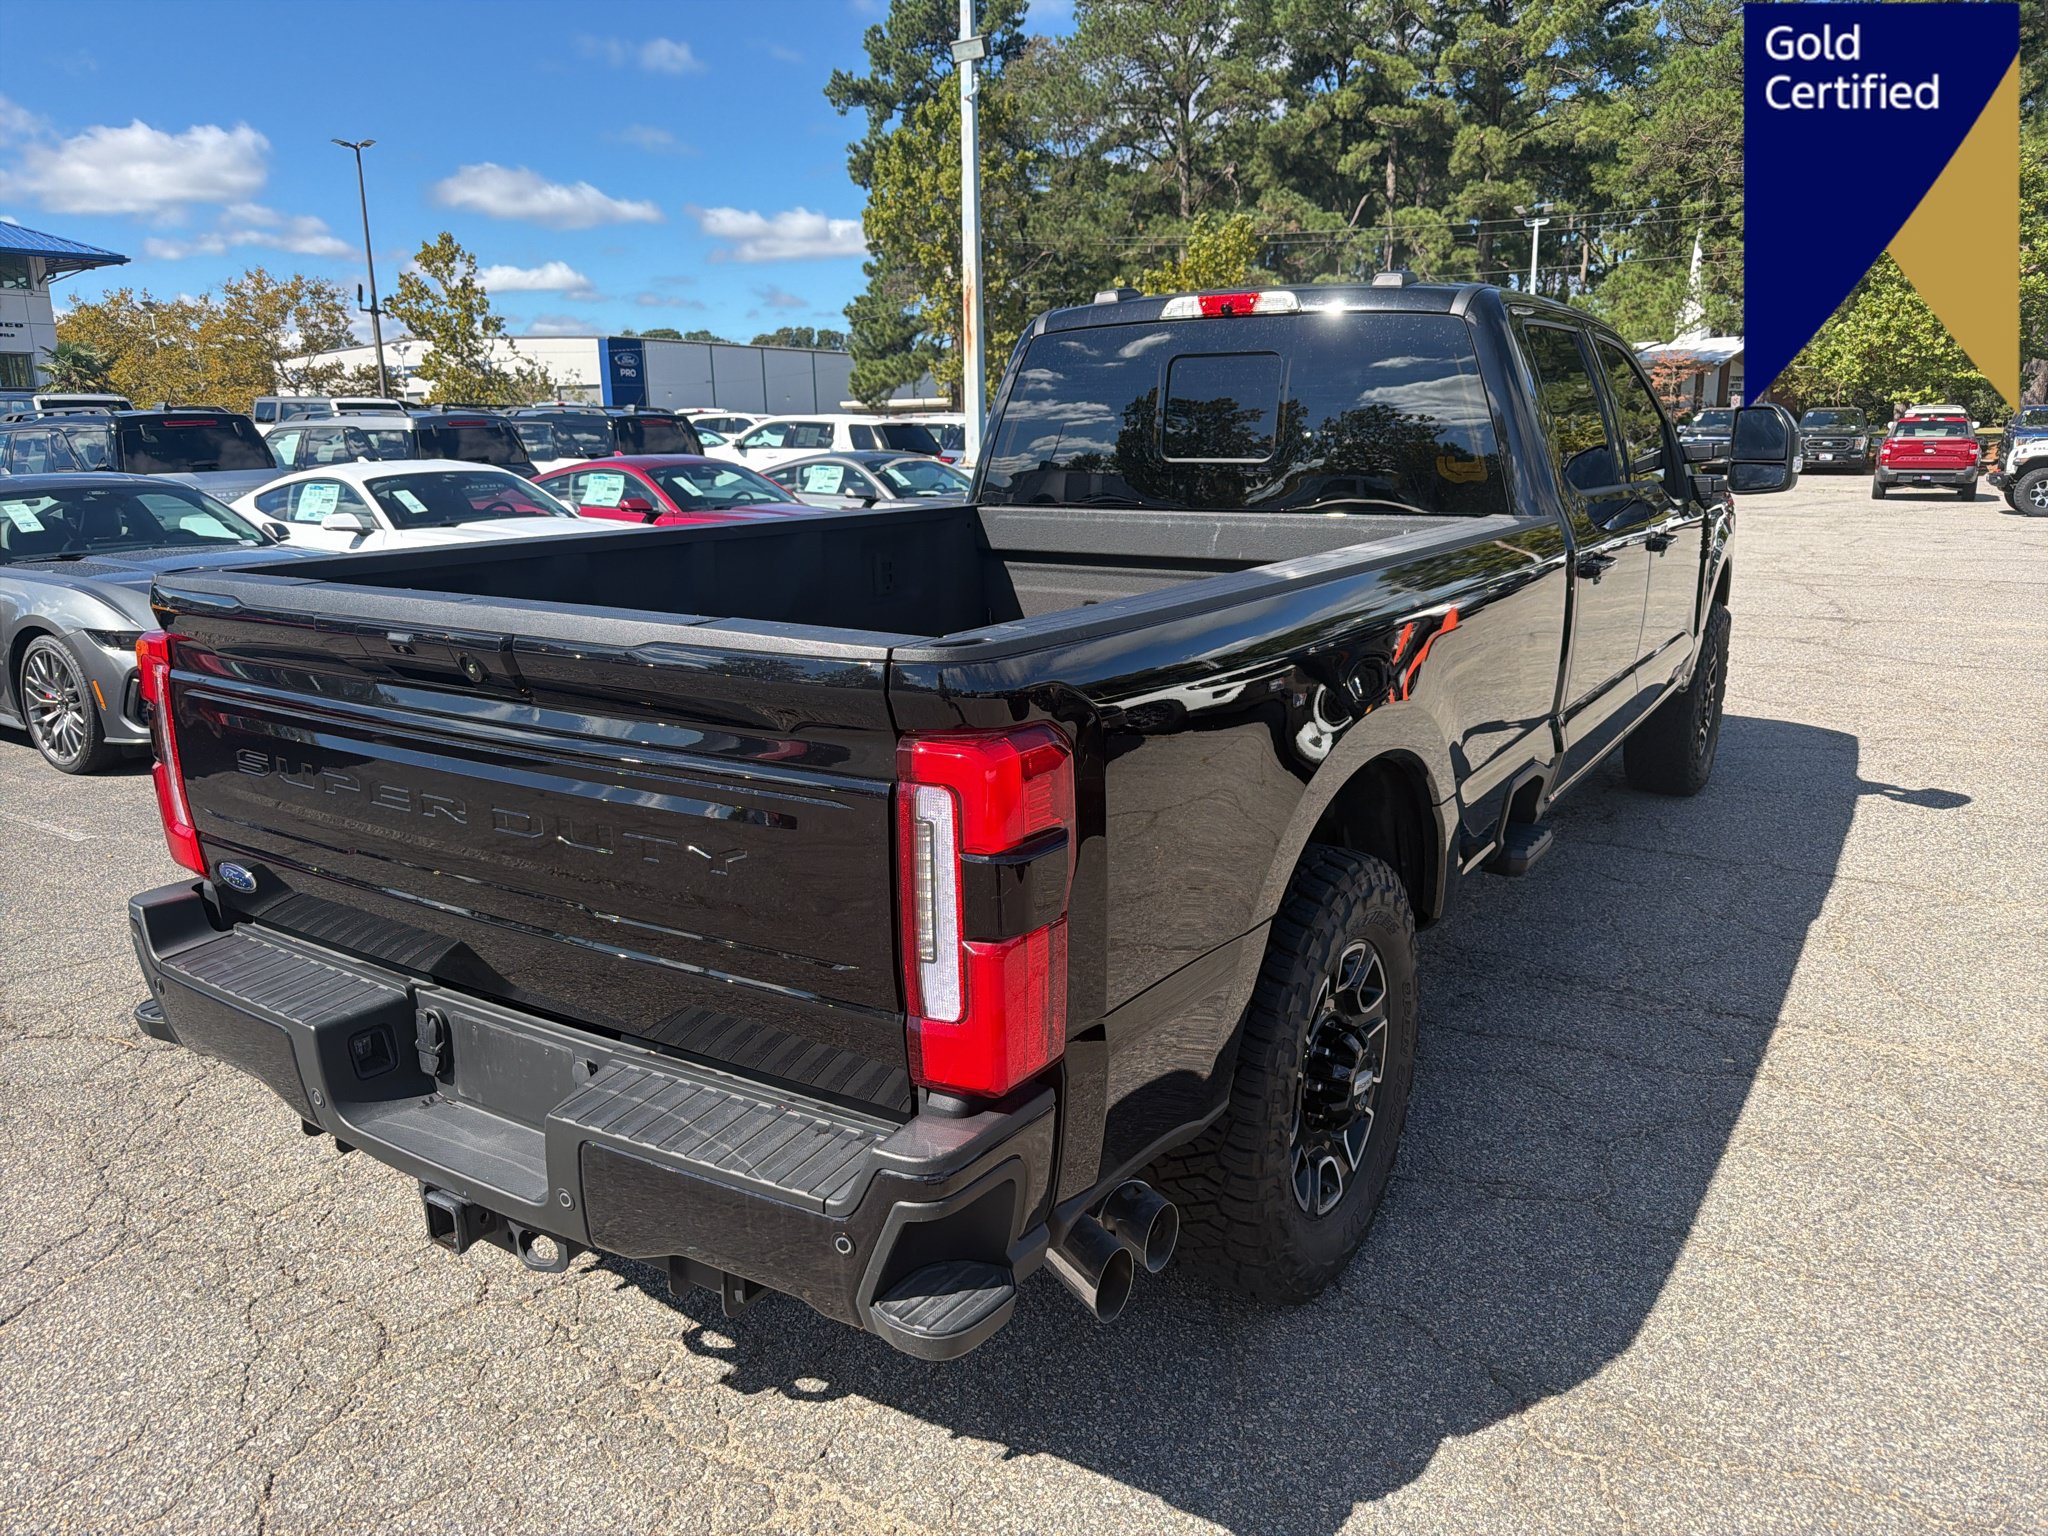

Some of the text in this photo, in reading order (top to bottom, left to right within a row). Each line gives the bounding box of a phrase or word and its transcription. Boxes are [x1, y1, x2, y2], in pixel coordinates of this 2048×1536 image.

[620, 368, 637, 378] PRO
[236, 748, 748, 877] SUPER DUTY
[1398, 981, 1413, 1059] OPEN
